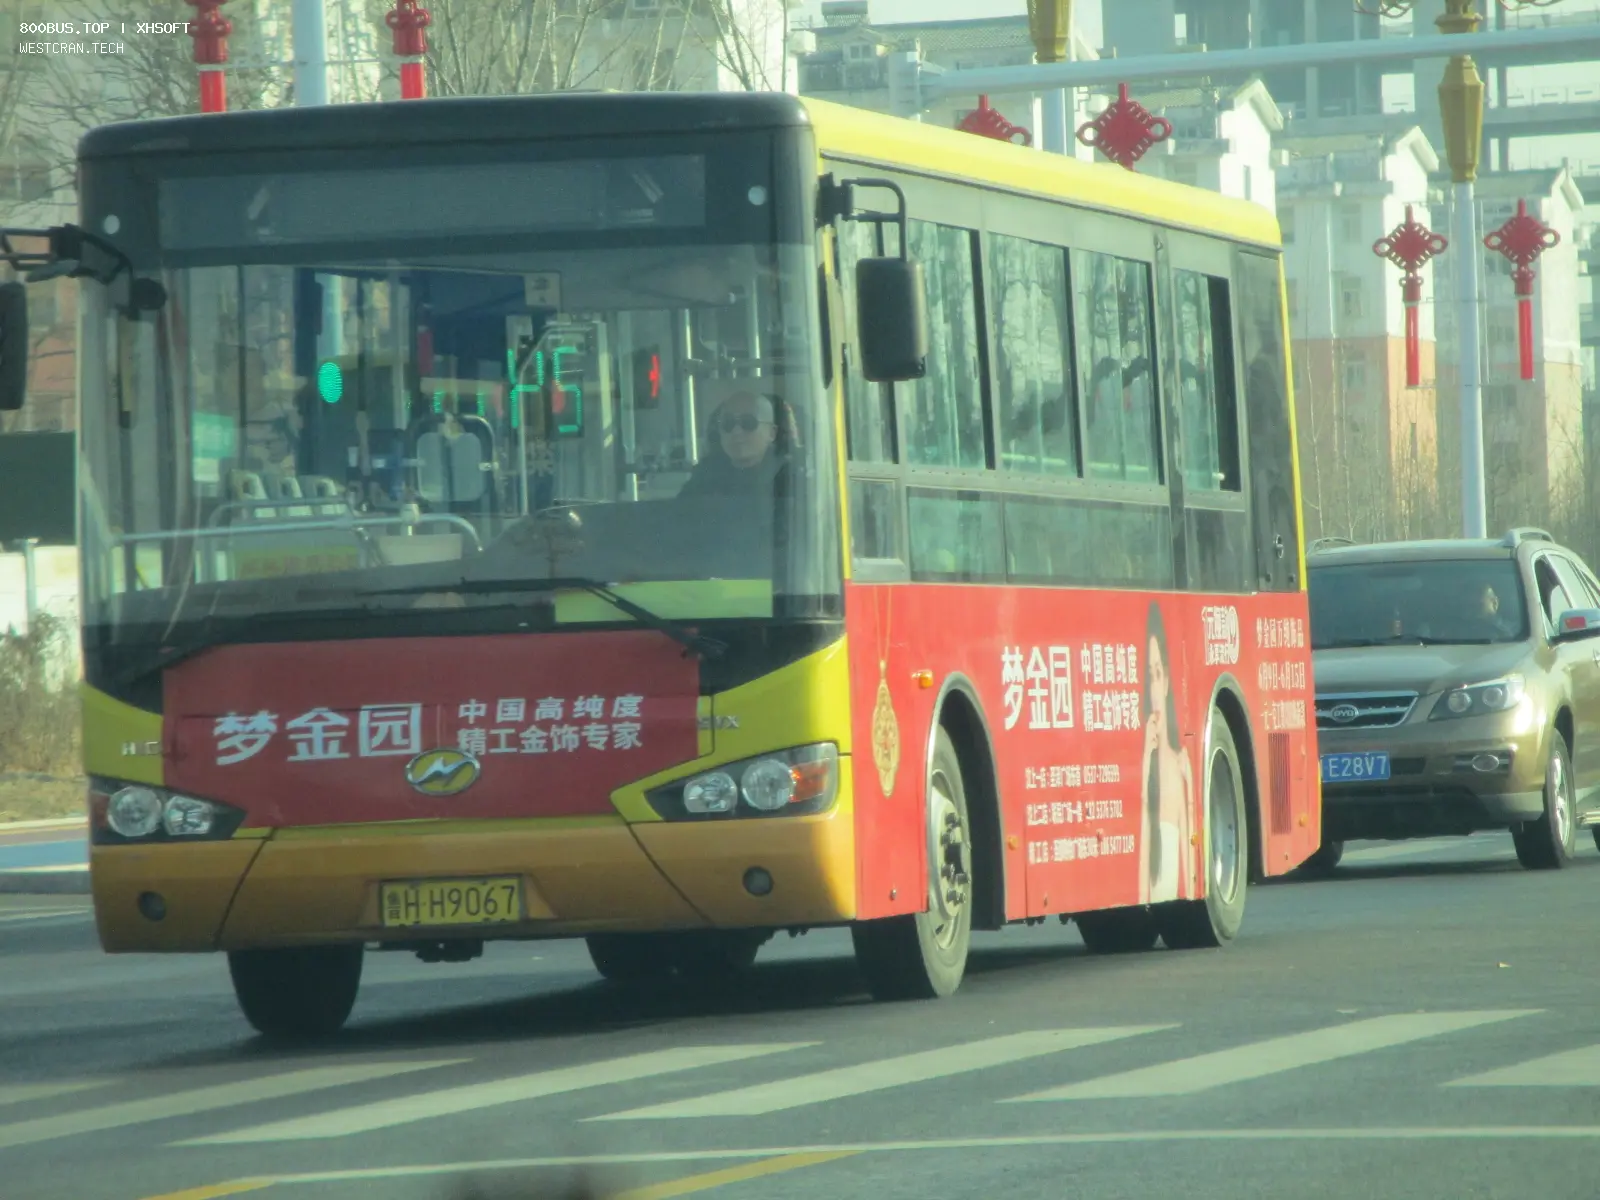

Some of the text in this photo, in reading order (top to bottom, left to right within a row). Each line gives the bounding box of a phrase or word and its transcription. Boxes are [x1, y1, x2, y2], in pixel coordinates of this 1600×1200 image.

[1080, 642, 1139, 685] 中国高纯度
[458, 693, 644, 725] 中国高纯度
[1001, 645, 1075, 731] 梦金园
[1082, 689, 1141, 732] 精工金饰专家
[213, 703, 423, 766] 梦金园
[457, 721, 643, 756] 精工金饰专家
[1328, 755, 1387, 778] E28V7
